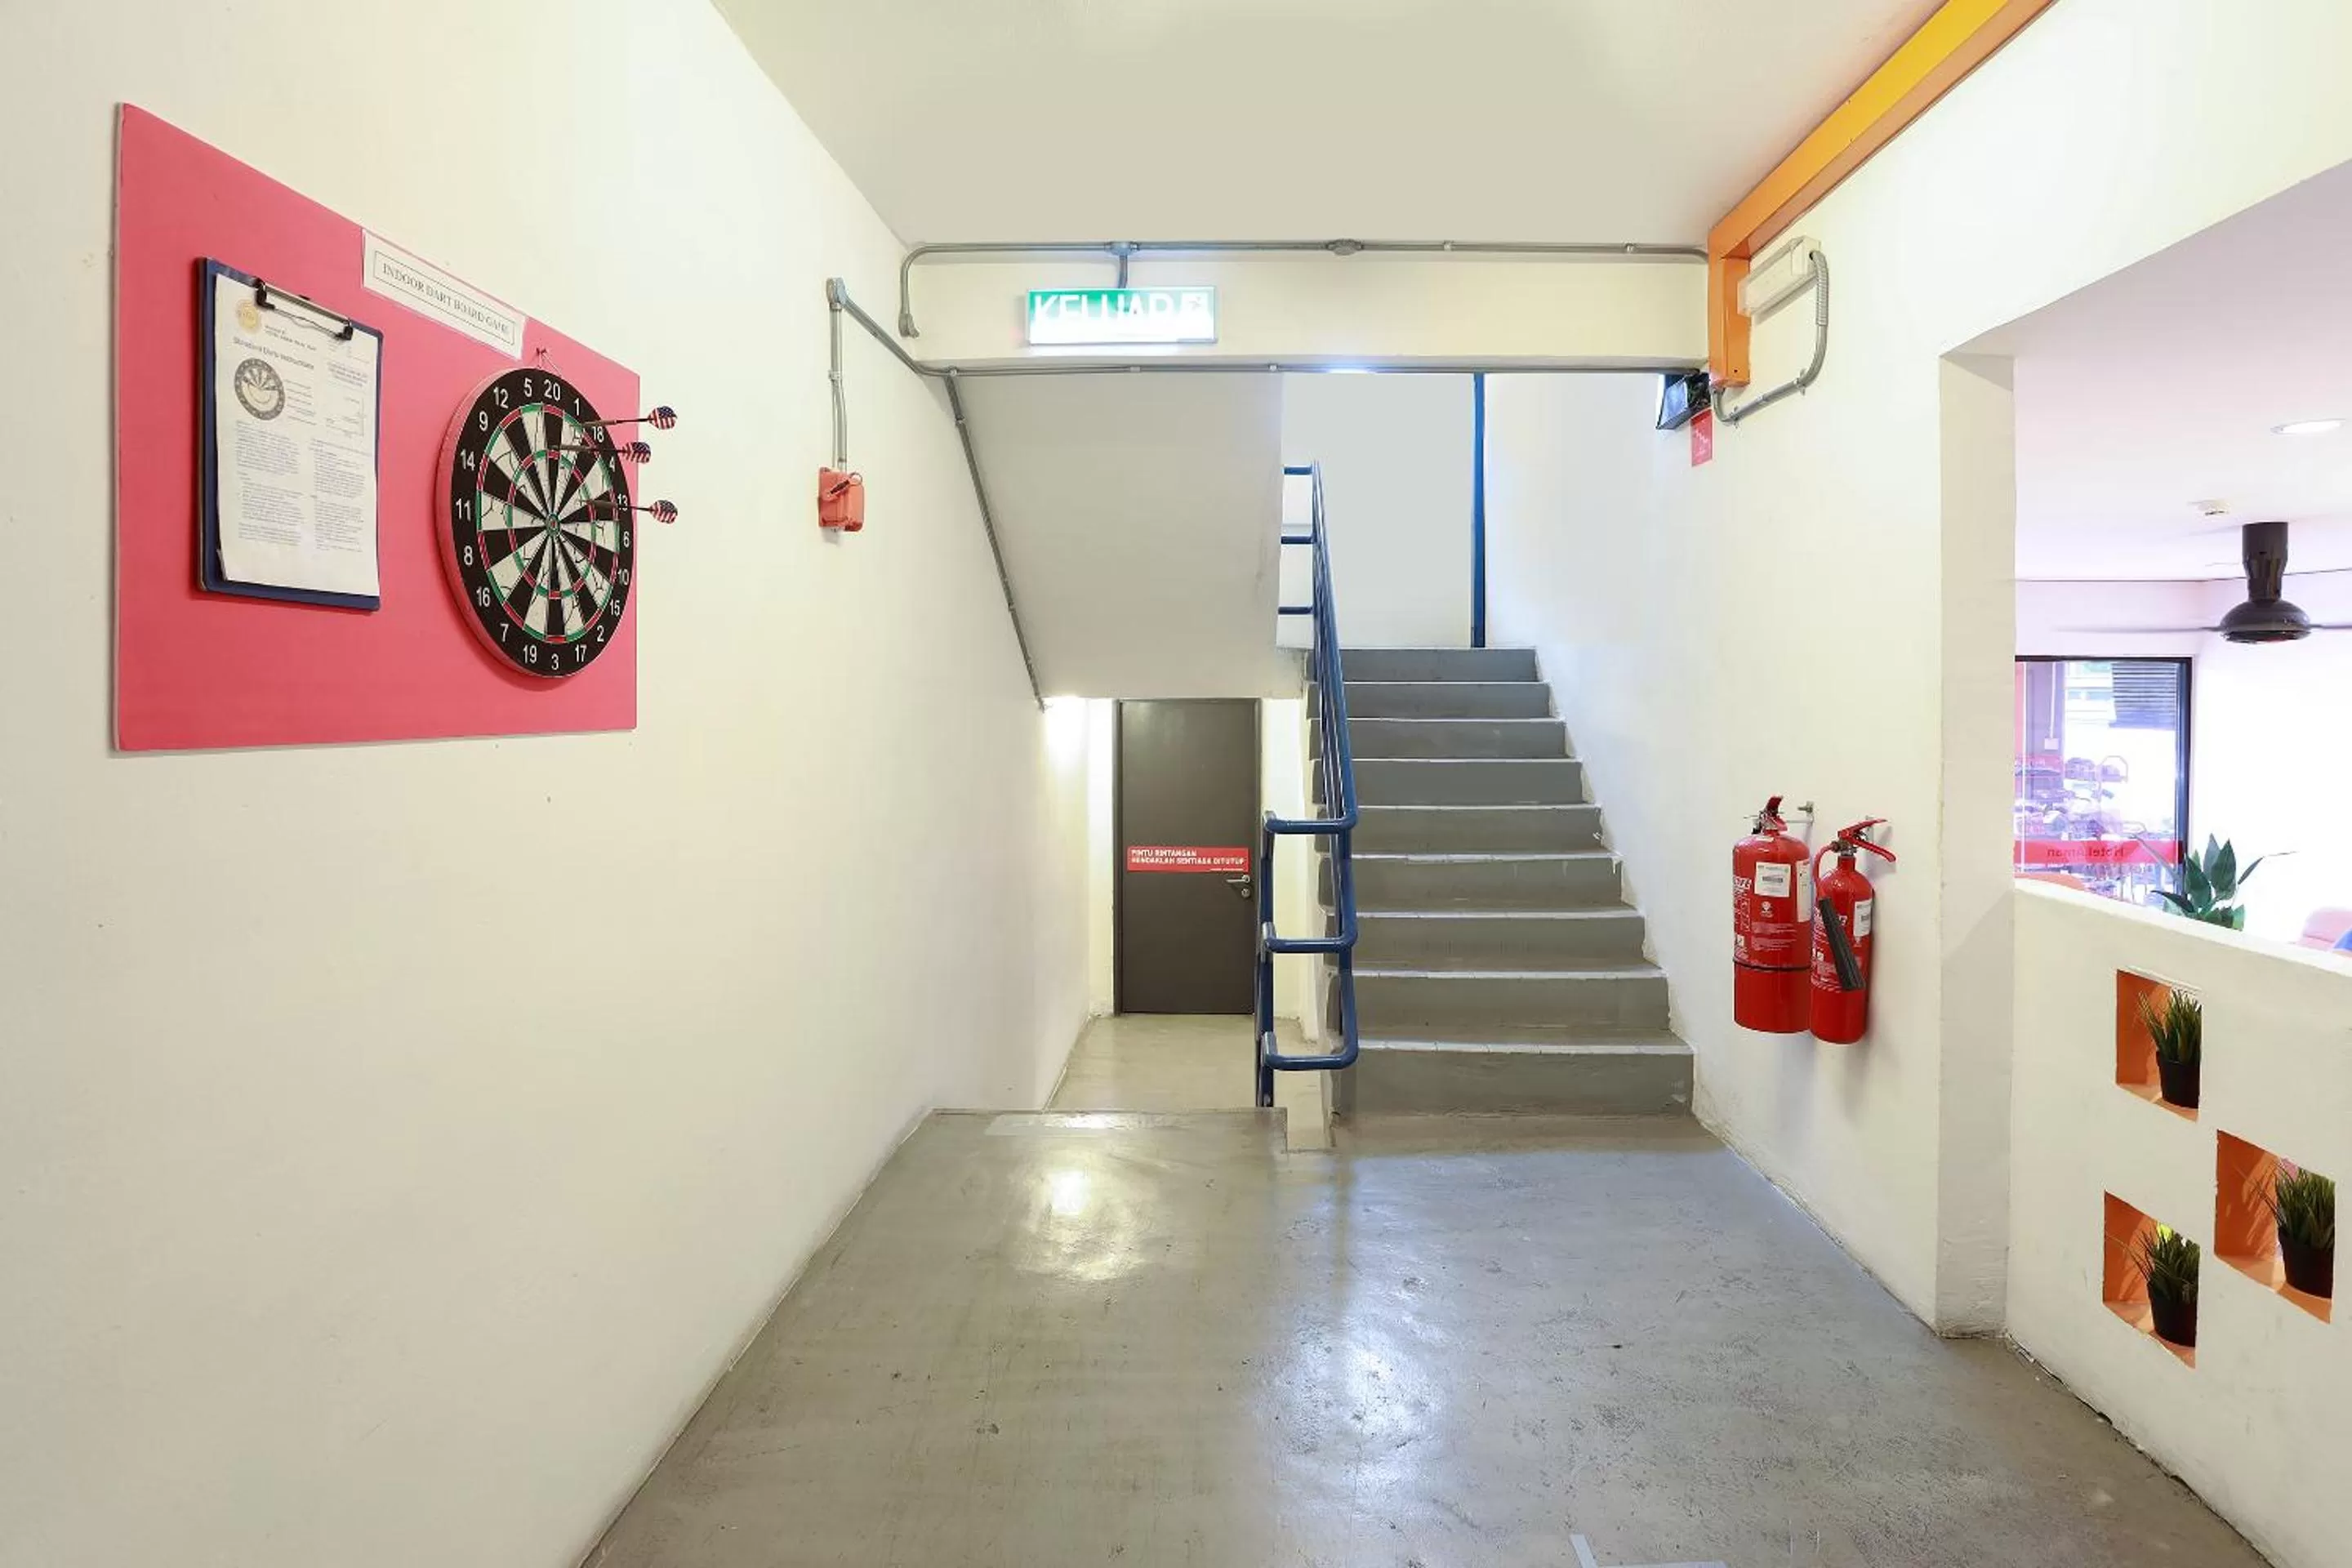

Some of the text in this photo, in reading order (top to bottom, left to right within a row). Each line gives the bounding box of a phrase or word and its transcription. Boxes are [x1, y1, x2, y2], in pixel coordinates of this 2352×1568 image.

[383, 262, 510, 335] INDOOR DART BOARD GAME
[492, 386, 510, 409] 12
[523, 377, 532, 398] 5
[543, 379, 561, 401] 20
[574, 398, 581, 416] 1
[479, 410, 489, 432] 9
[591, 425, 604, 443] 18
[460, 449, 476, 471] 14
[608, 456, 616, 473] 4
[455, 498, 471, 521] 11
[623, 531, 630, 548] 6
[463, 545, 474, 566] 8
[617, 568, 630, 586] 10
[475, 586, 491, 608] 16
[610, 599, 621, 617] 15
[499, 623, 510, 643] 7
[596, 625, 605, 643] 2
[523, 644, 538, 664] 19
[550, 653, 559, 671] 3
[574, 644, 587, 663] 17
[1130, 849, 1152, 857] PINTU
